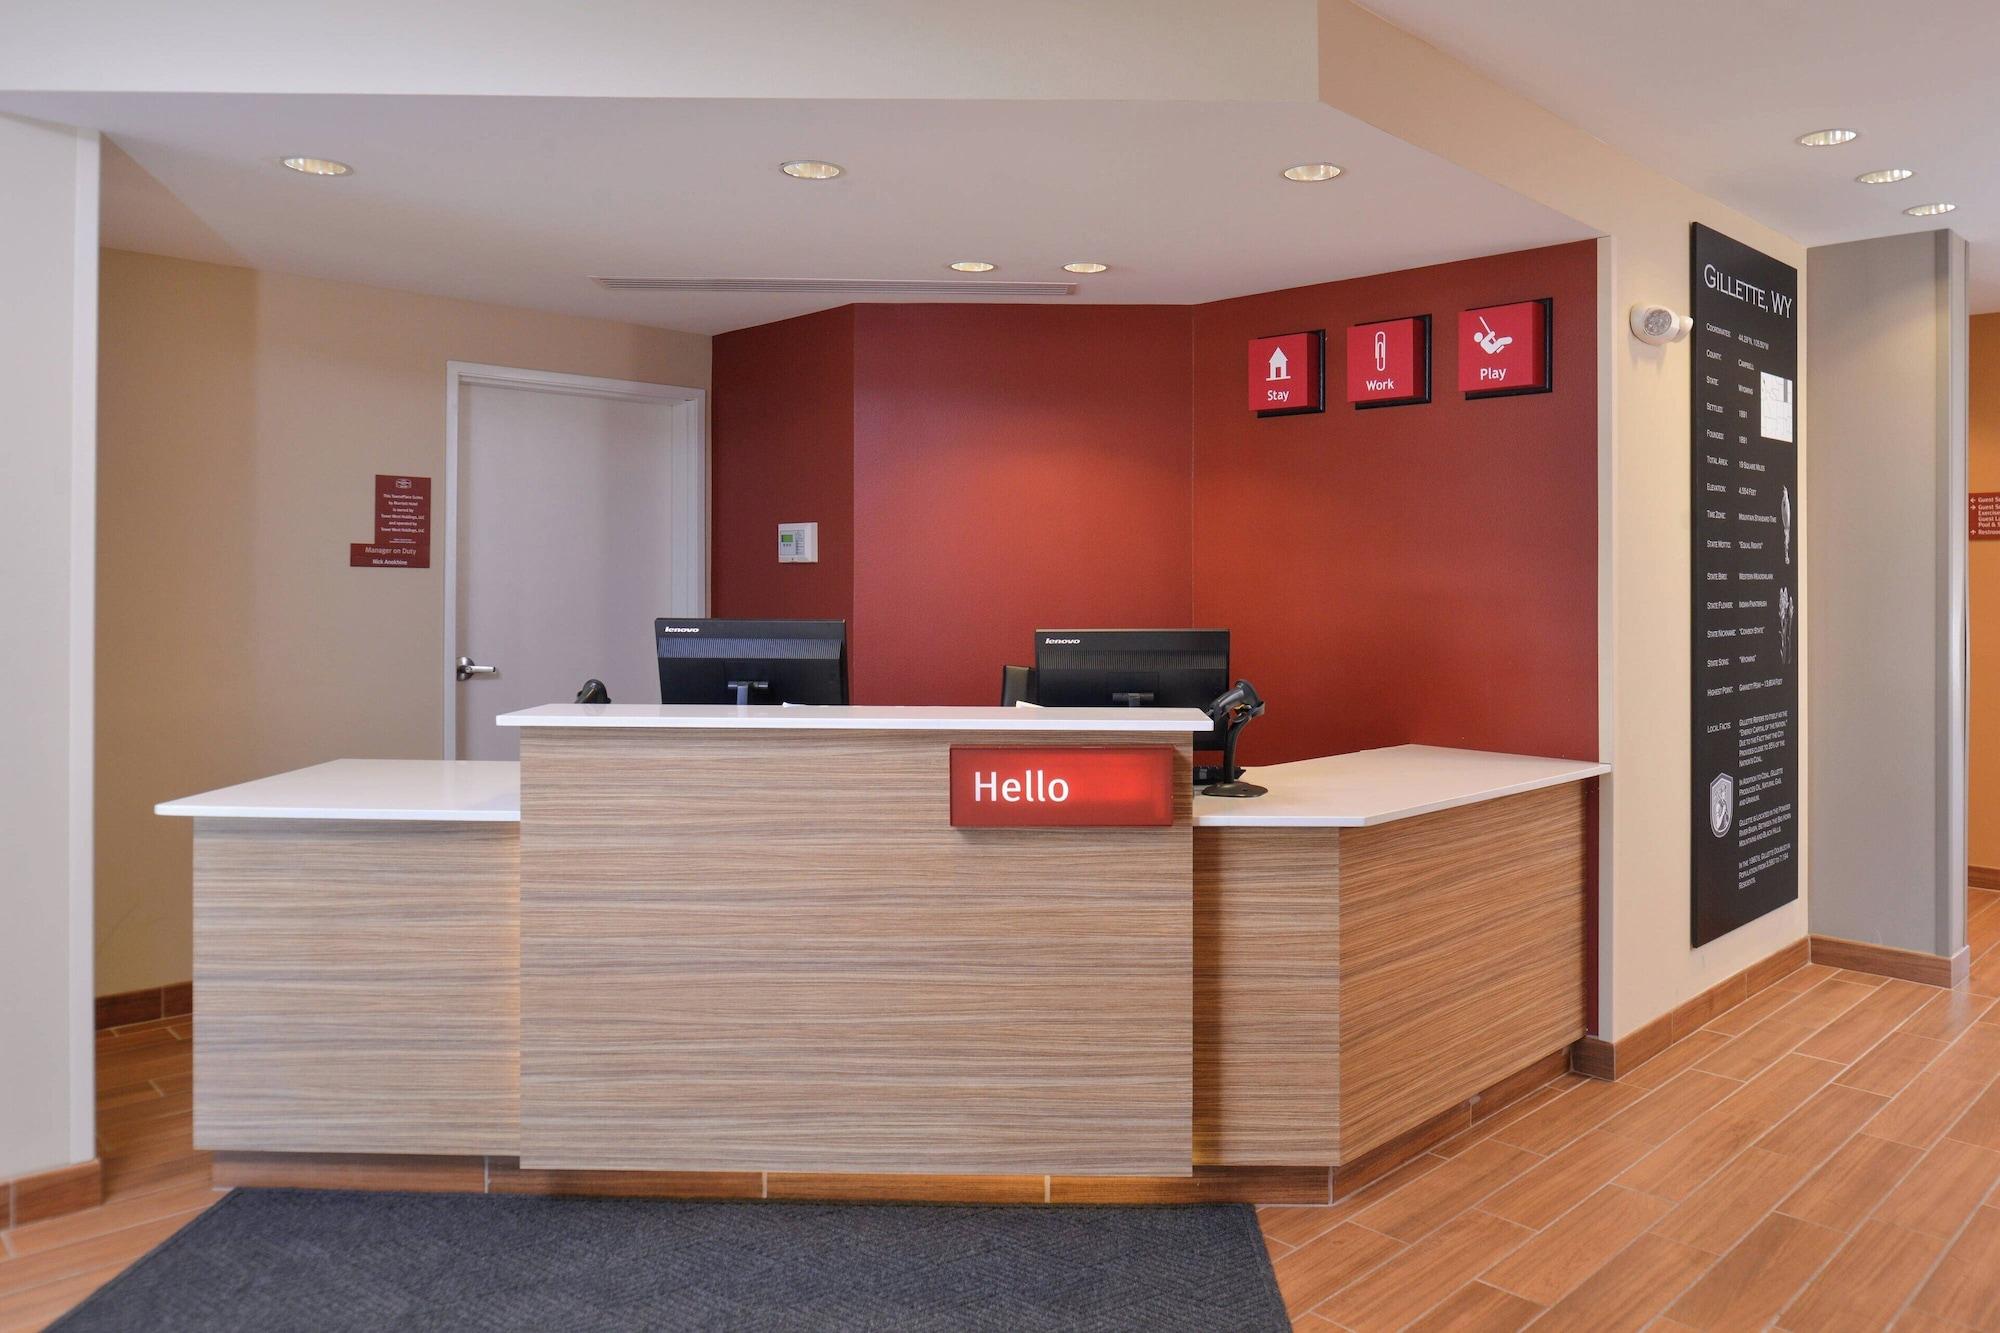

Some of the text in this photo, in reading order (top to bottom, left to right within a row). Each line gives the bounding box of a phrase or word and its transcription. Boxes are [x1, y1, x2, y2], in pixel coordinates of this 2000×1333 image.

[1704, 264, 1792, 318] GILLETTE, WY
[1480, 368, 1506, 381] Play
[1366, 378, 1394, 392] Work
[1267, 390, 1290, 402] Stay
[974, 770, 1069, 802] Hello
